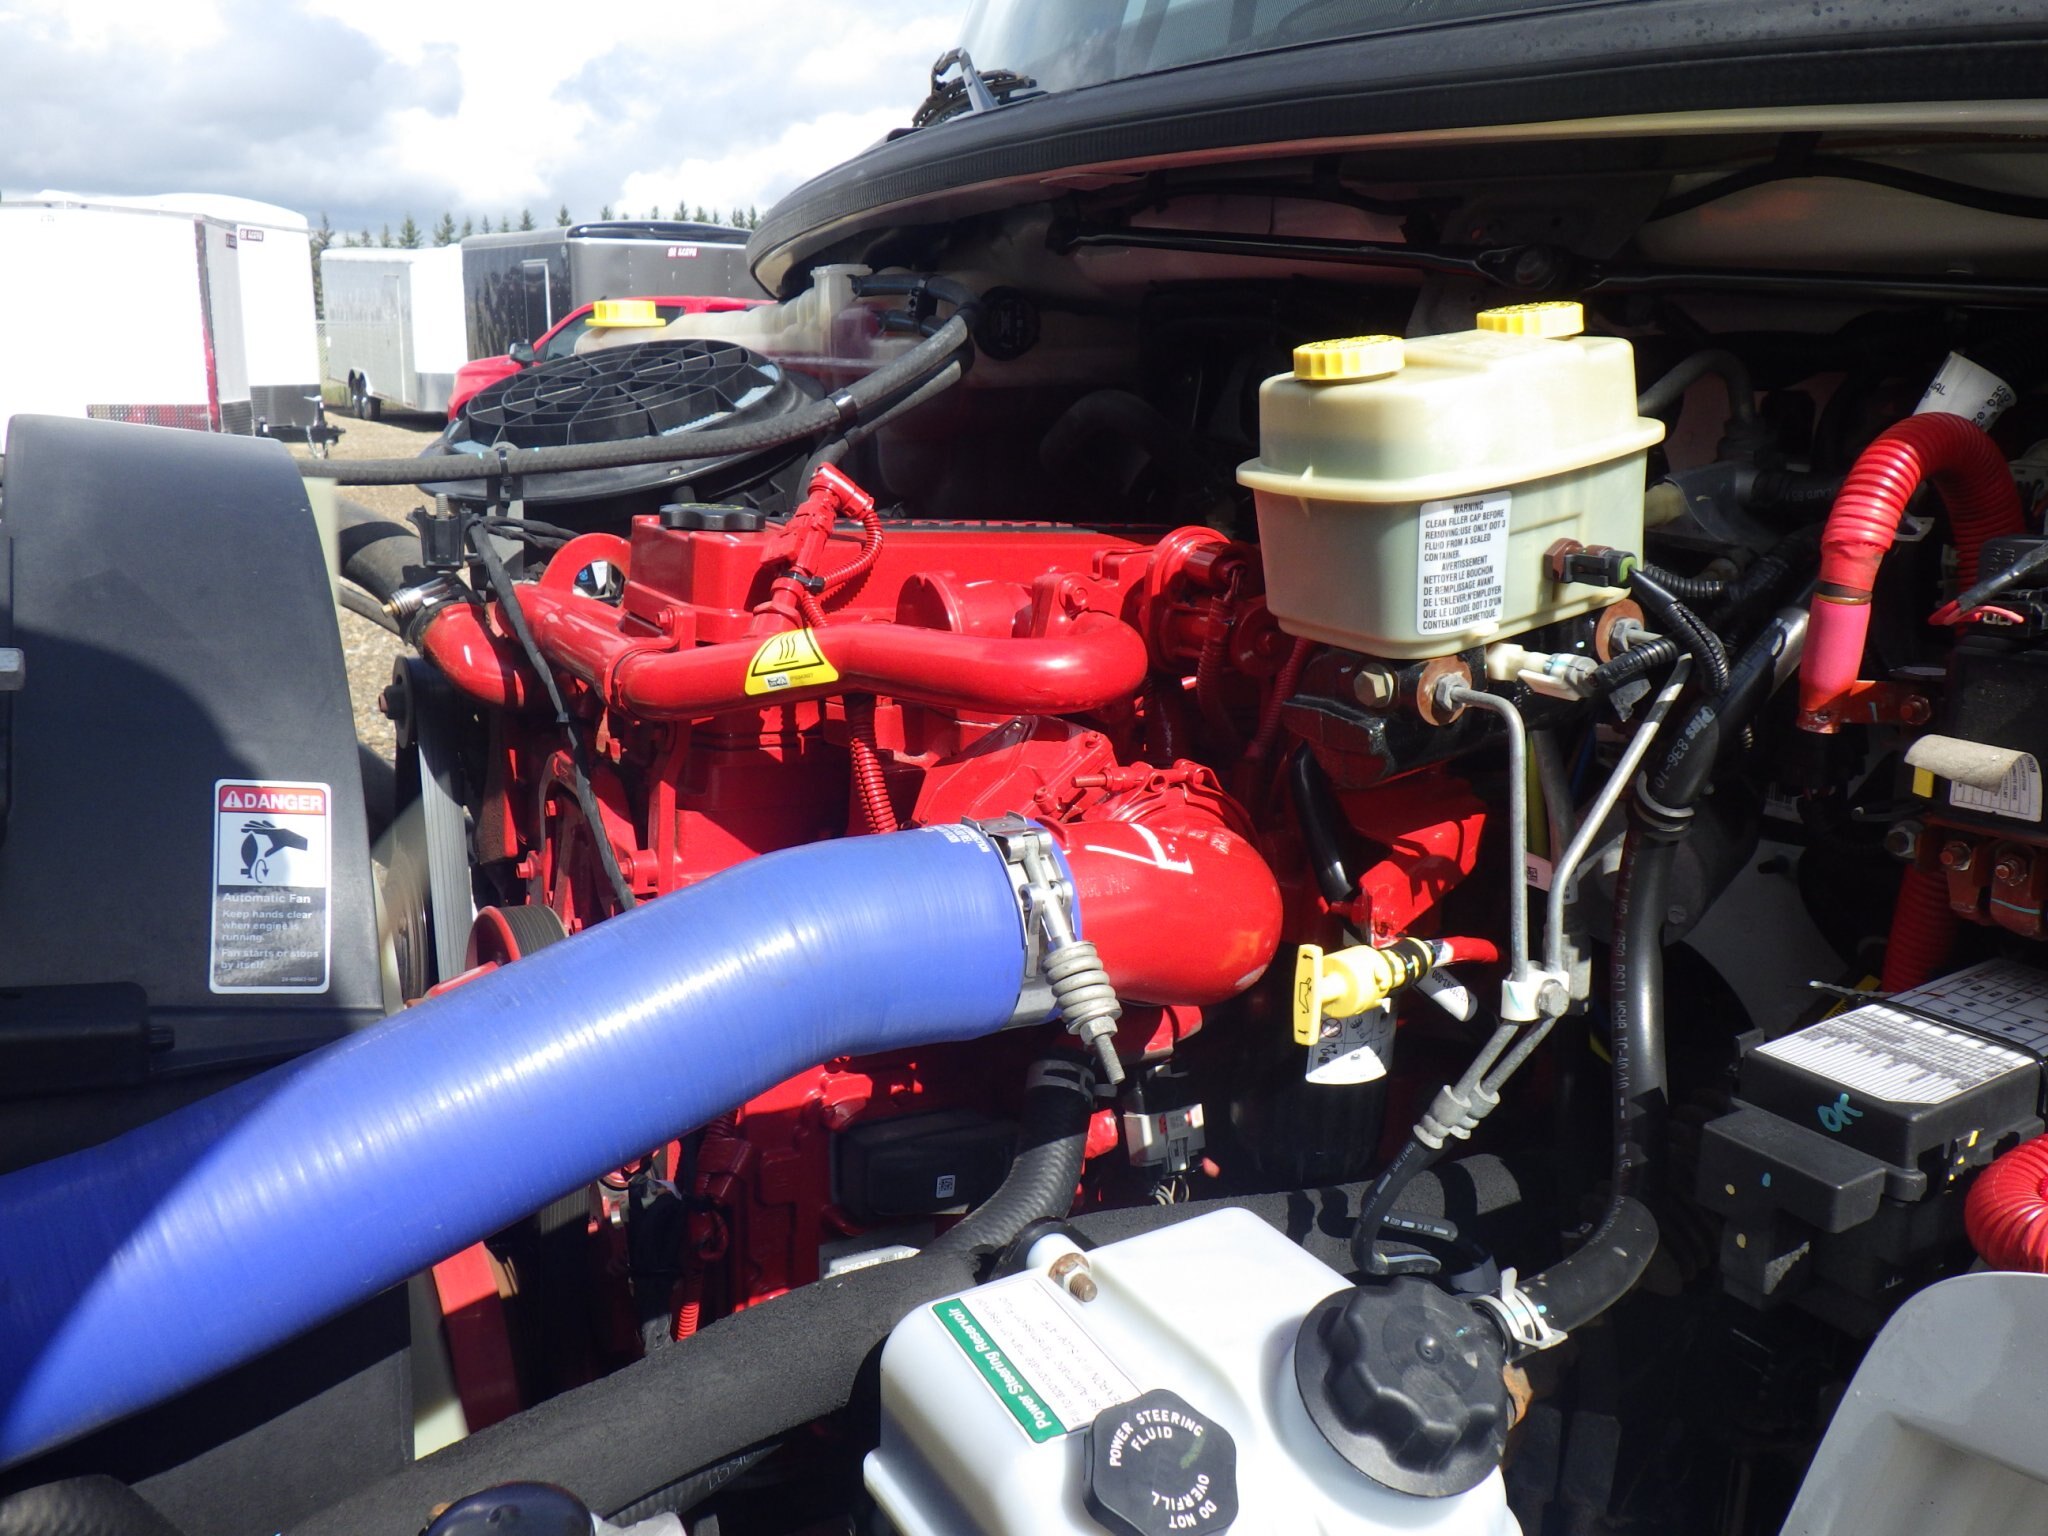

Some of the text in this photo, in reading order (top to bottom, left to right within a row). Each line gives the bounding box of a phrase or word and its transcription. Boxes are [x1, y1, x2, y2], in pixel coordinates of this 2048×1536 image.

[1453, 501, 1484, 514] WARNING
[1425, 509, 1504, 529] CLEAN FILLER CAP BEFORE
[1473, 523, 1487, 533] ONLY
[1489, 521, 1501, 530] DOT
[1502, 520, 1506, 528] 3
[1424, 533, 1491, 551] FLUID FROM A SEALED
[1442, 555, 1488, 571] AVERTISSEMENT
[1424, 565, 1494, 584] NETTOYER LE BOUCHON
[1424, 576, 1494, 596] DE REMPLISSAGE AVANT
[1423, 598, 1432, 607] DE
[1423, 597, 1502, 619] QUE LE LIQUIDE DOT 3 D'UN
[1423, 617, 1461, 630] CONTENANT
[244, 793, 323, 811] DANGER
[222, 892, 311, 904] Automatic Fan
[222, 909, 312, 919] Keep hands clear
[222, 921, 299, 932] when engine is
[221, 948, 319, 959] Fan starts or stops
[221, 961, 234, 970] by
[1817, 1093, 1863, 1132] OK
[950, 1309, 1051, 1429] Power Steering Reservoir
[1109, 1409, 1204, 1467] POWER STEERING
[1130, 1426, 1172, 1452] FLUID
[1151, 1474, 1210, 1511] OVERFILL
[1168, 1499, 1217, 1529] DO NOT
